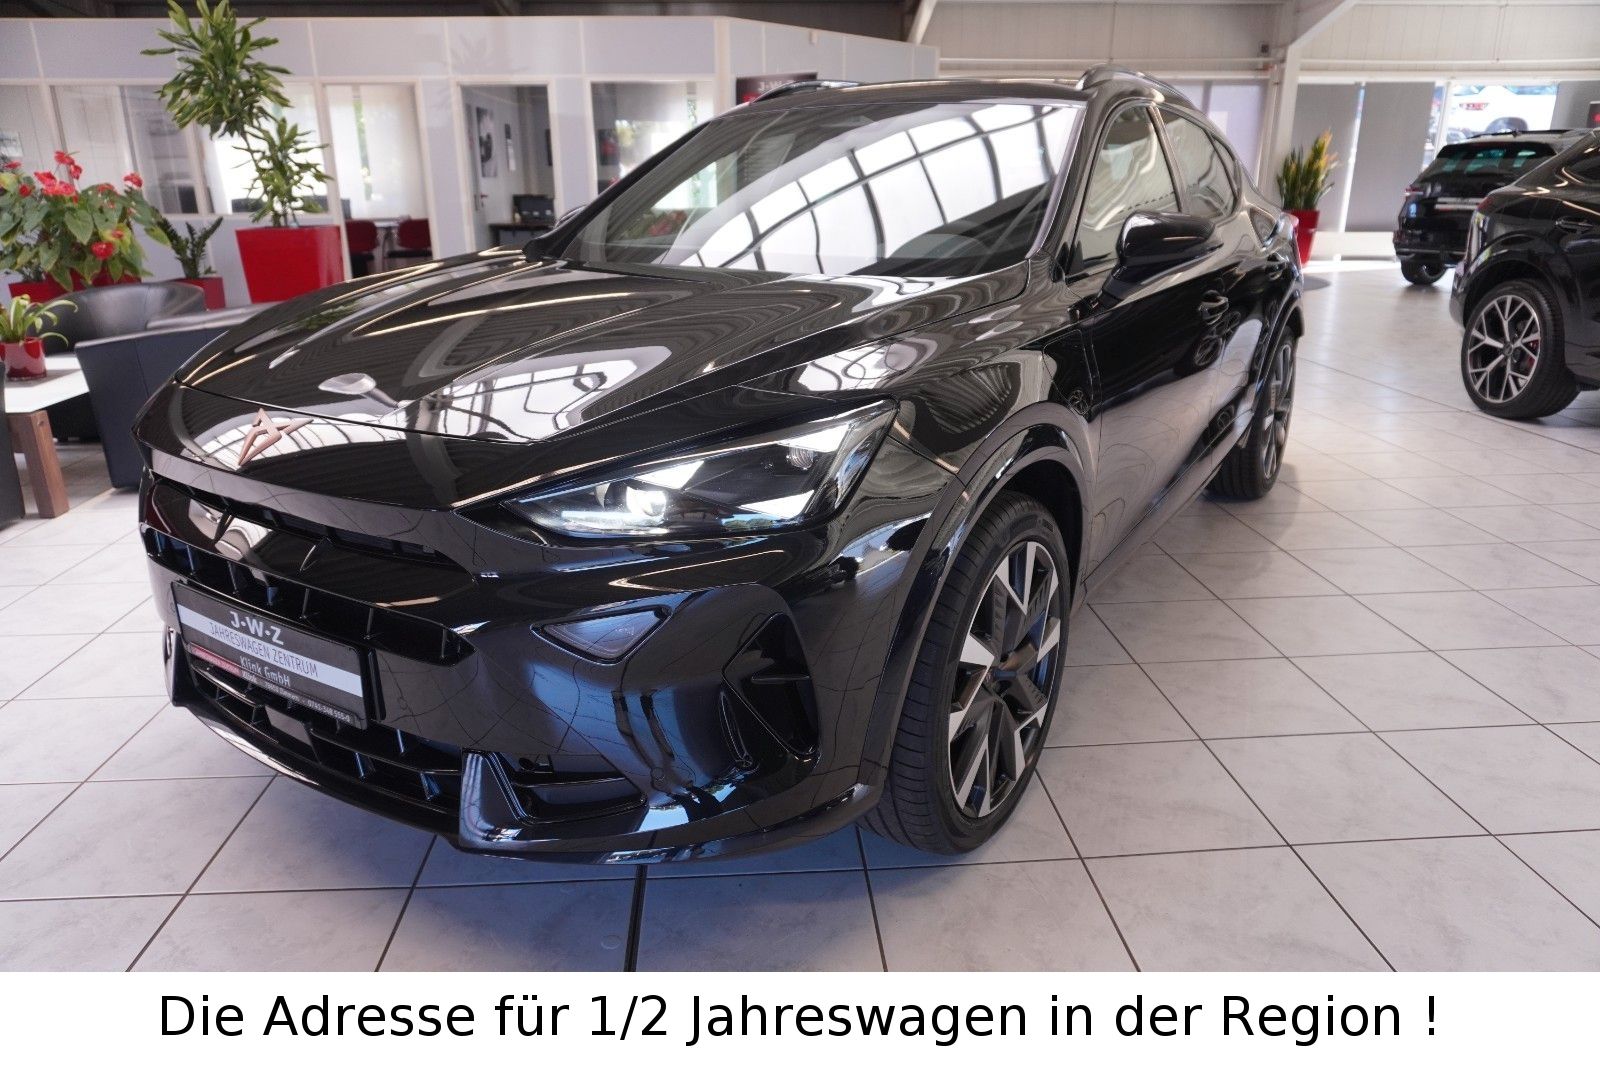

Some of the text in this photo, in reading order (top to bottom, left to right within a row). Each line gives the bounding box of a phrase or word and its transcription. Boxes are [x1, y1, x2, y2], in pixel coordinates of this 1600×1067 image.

[208, 621, 271, 660] JAHRESWAGEN
[271, 648, 319, 678] ZENTRUM
[239, 656, 262, 675] Klink
[264, 666, 291, 687] GmbH
